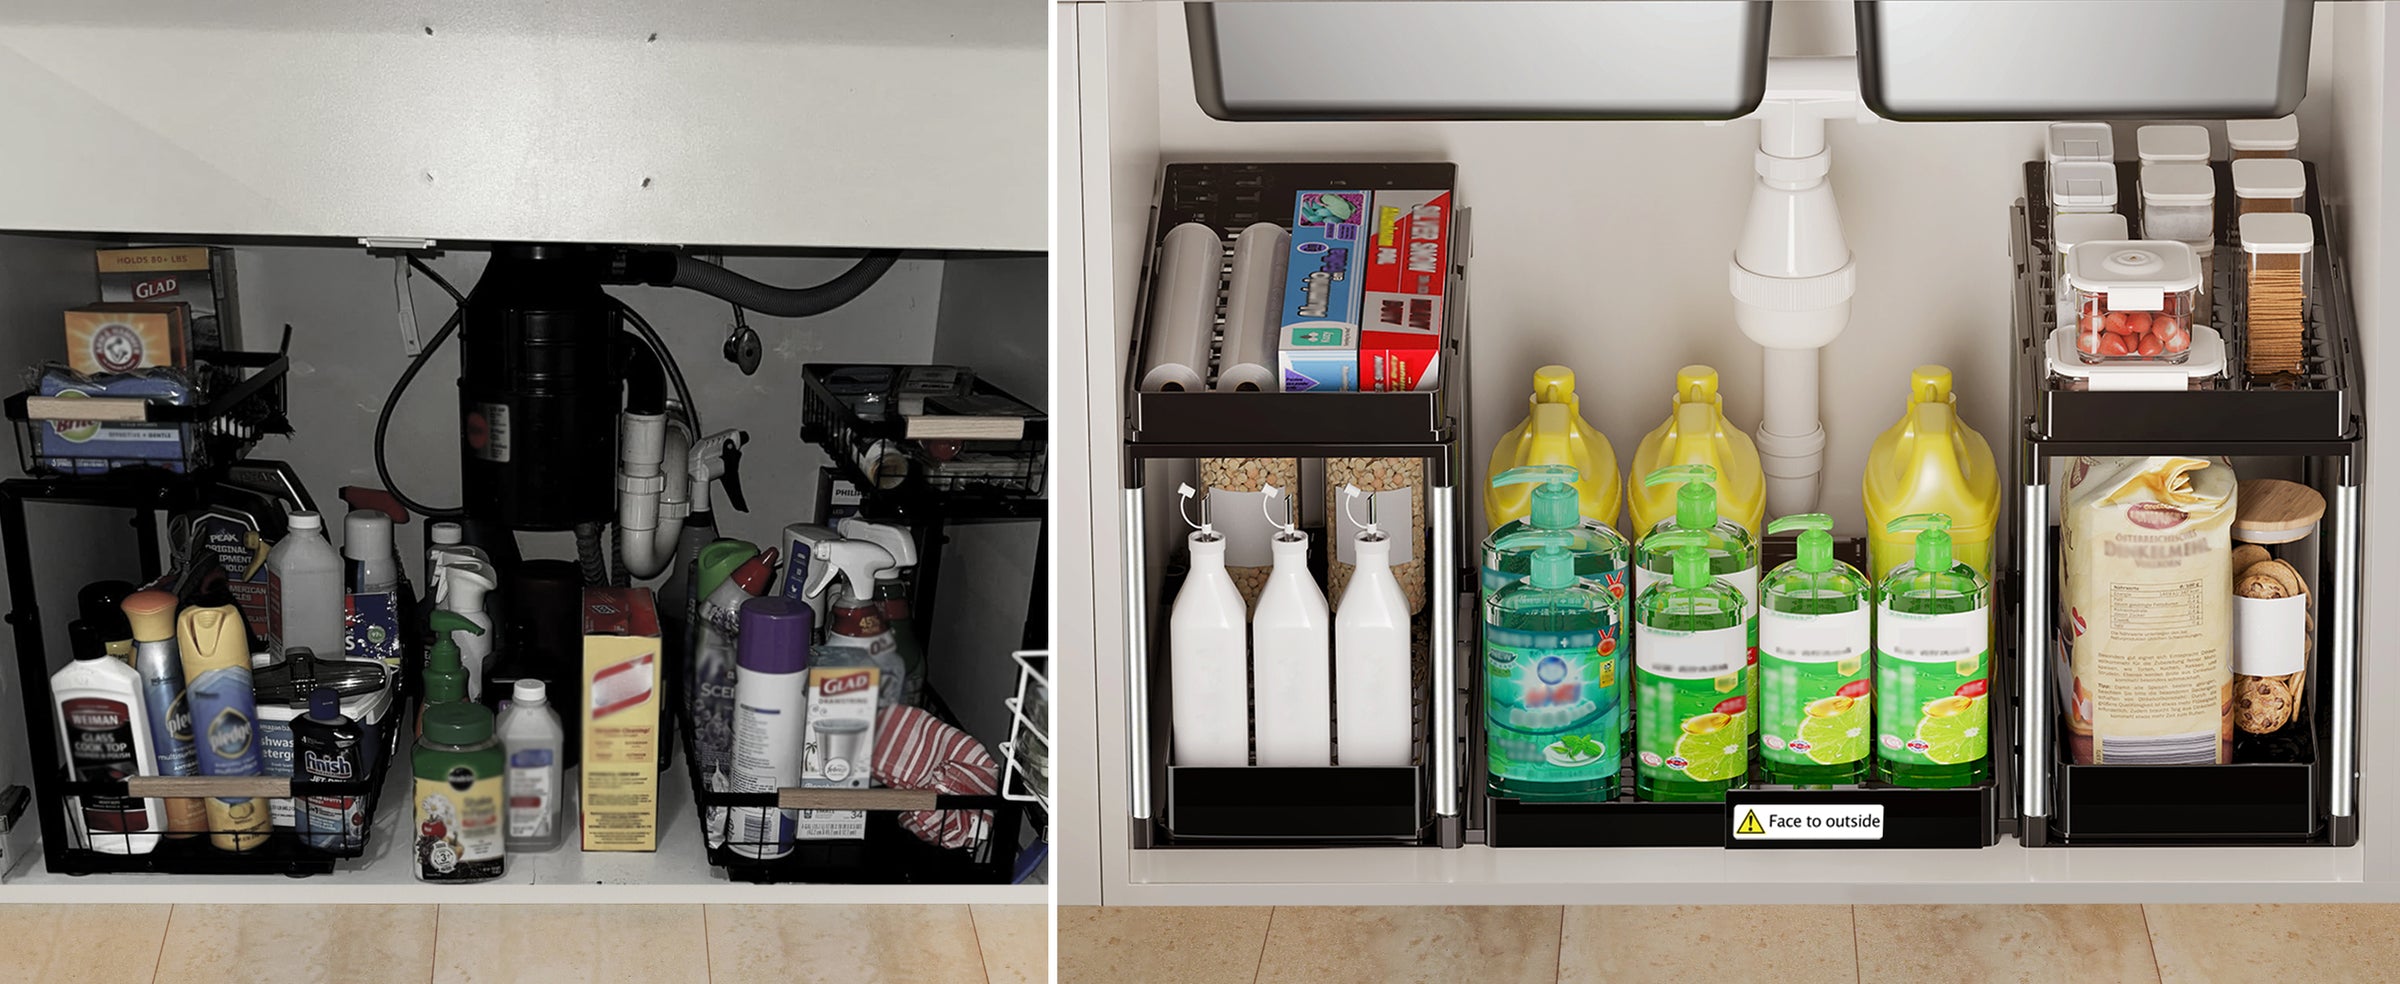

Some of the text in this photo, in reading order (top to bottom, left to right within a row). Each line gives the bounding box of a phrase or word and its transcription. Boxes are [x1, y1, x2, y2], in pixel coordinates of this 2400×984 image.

[117, 255, 148, 264] HOLDS
[135, 279, 177, 299] GLAD
[209, 533, 239, 543] PEAK
[823, 674, 868, 695] GLAD
[71, 714, 119, 726] WEIMAN
[105, 742, 128, 752] TOP
[305, 751, 352, 777] finish
[851, 810, 863, 819] 34
[1769, 813, 1881, 828] Face to outside
